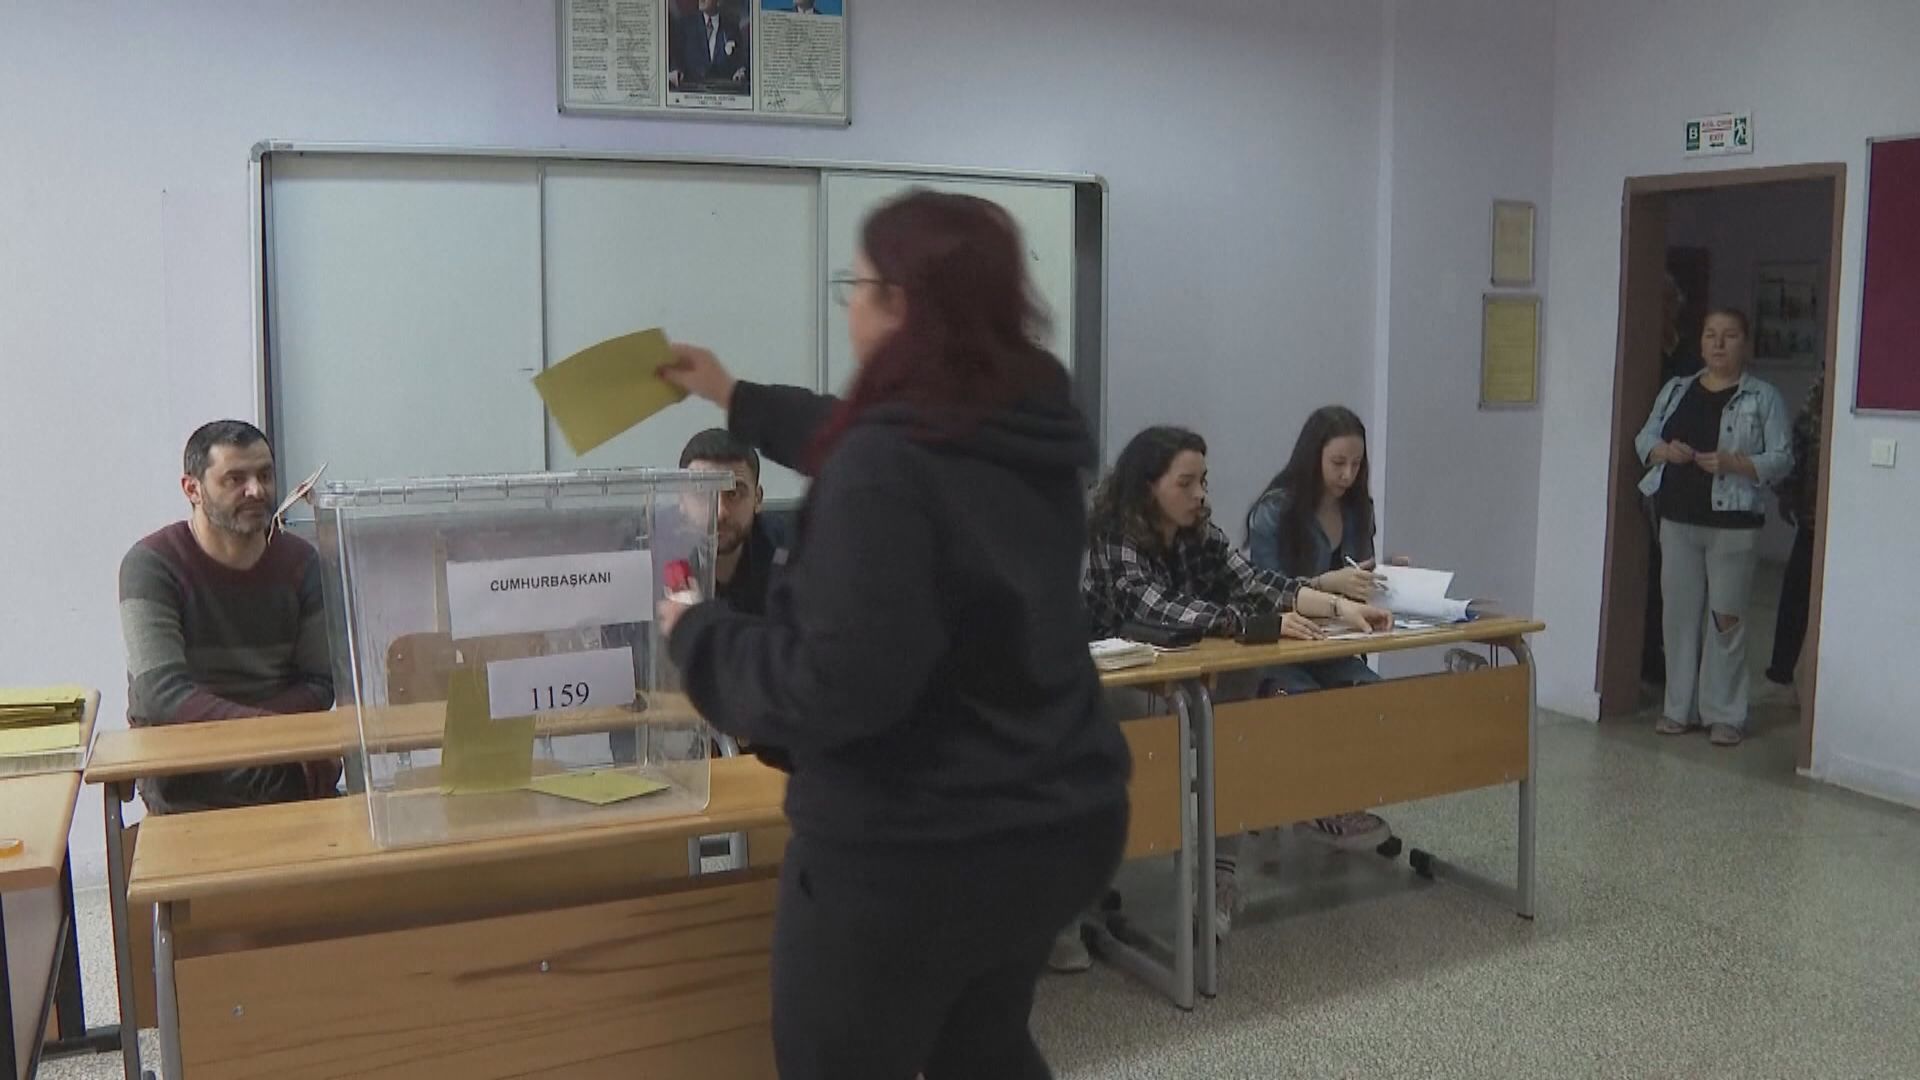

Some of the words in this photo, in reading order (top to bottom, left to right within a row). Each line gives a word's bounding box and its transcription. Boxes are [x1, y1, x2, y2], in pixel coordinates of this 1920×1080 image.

[1689, 127, 1698, 139] B
[490, 572, 611, 591] CUMHURBAŞKANI
[532, 682, 590, 710] 1159
